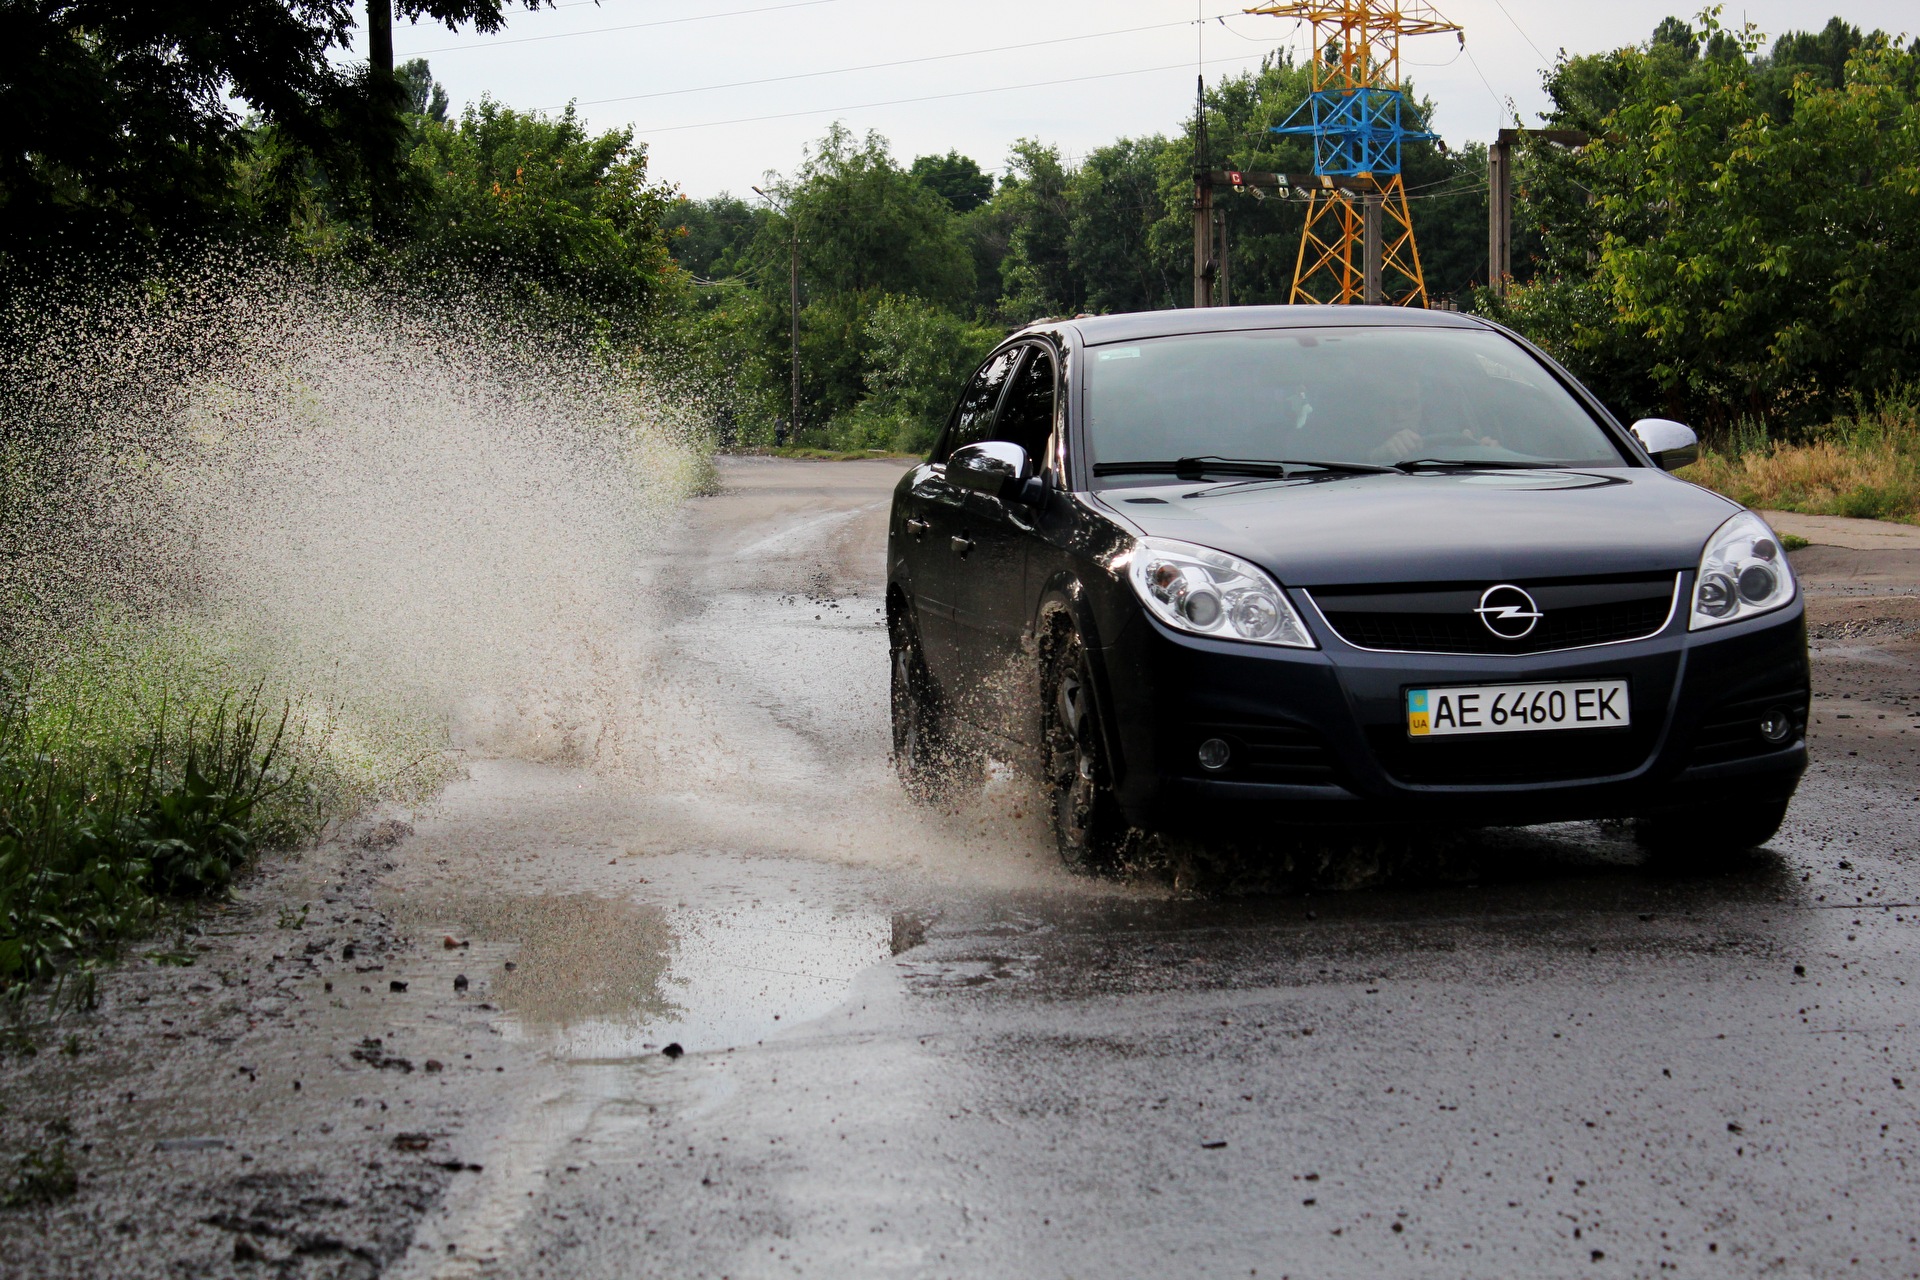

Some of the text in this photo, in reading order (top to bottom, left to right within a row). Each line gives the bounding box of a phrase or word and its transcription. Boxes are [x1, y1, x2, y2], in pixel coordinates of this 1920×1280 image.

[1434, 687, 1621, 729] AE 6460 EK
[1412, 719, 1428, 729] UA
